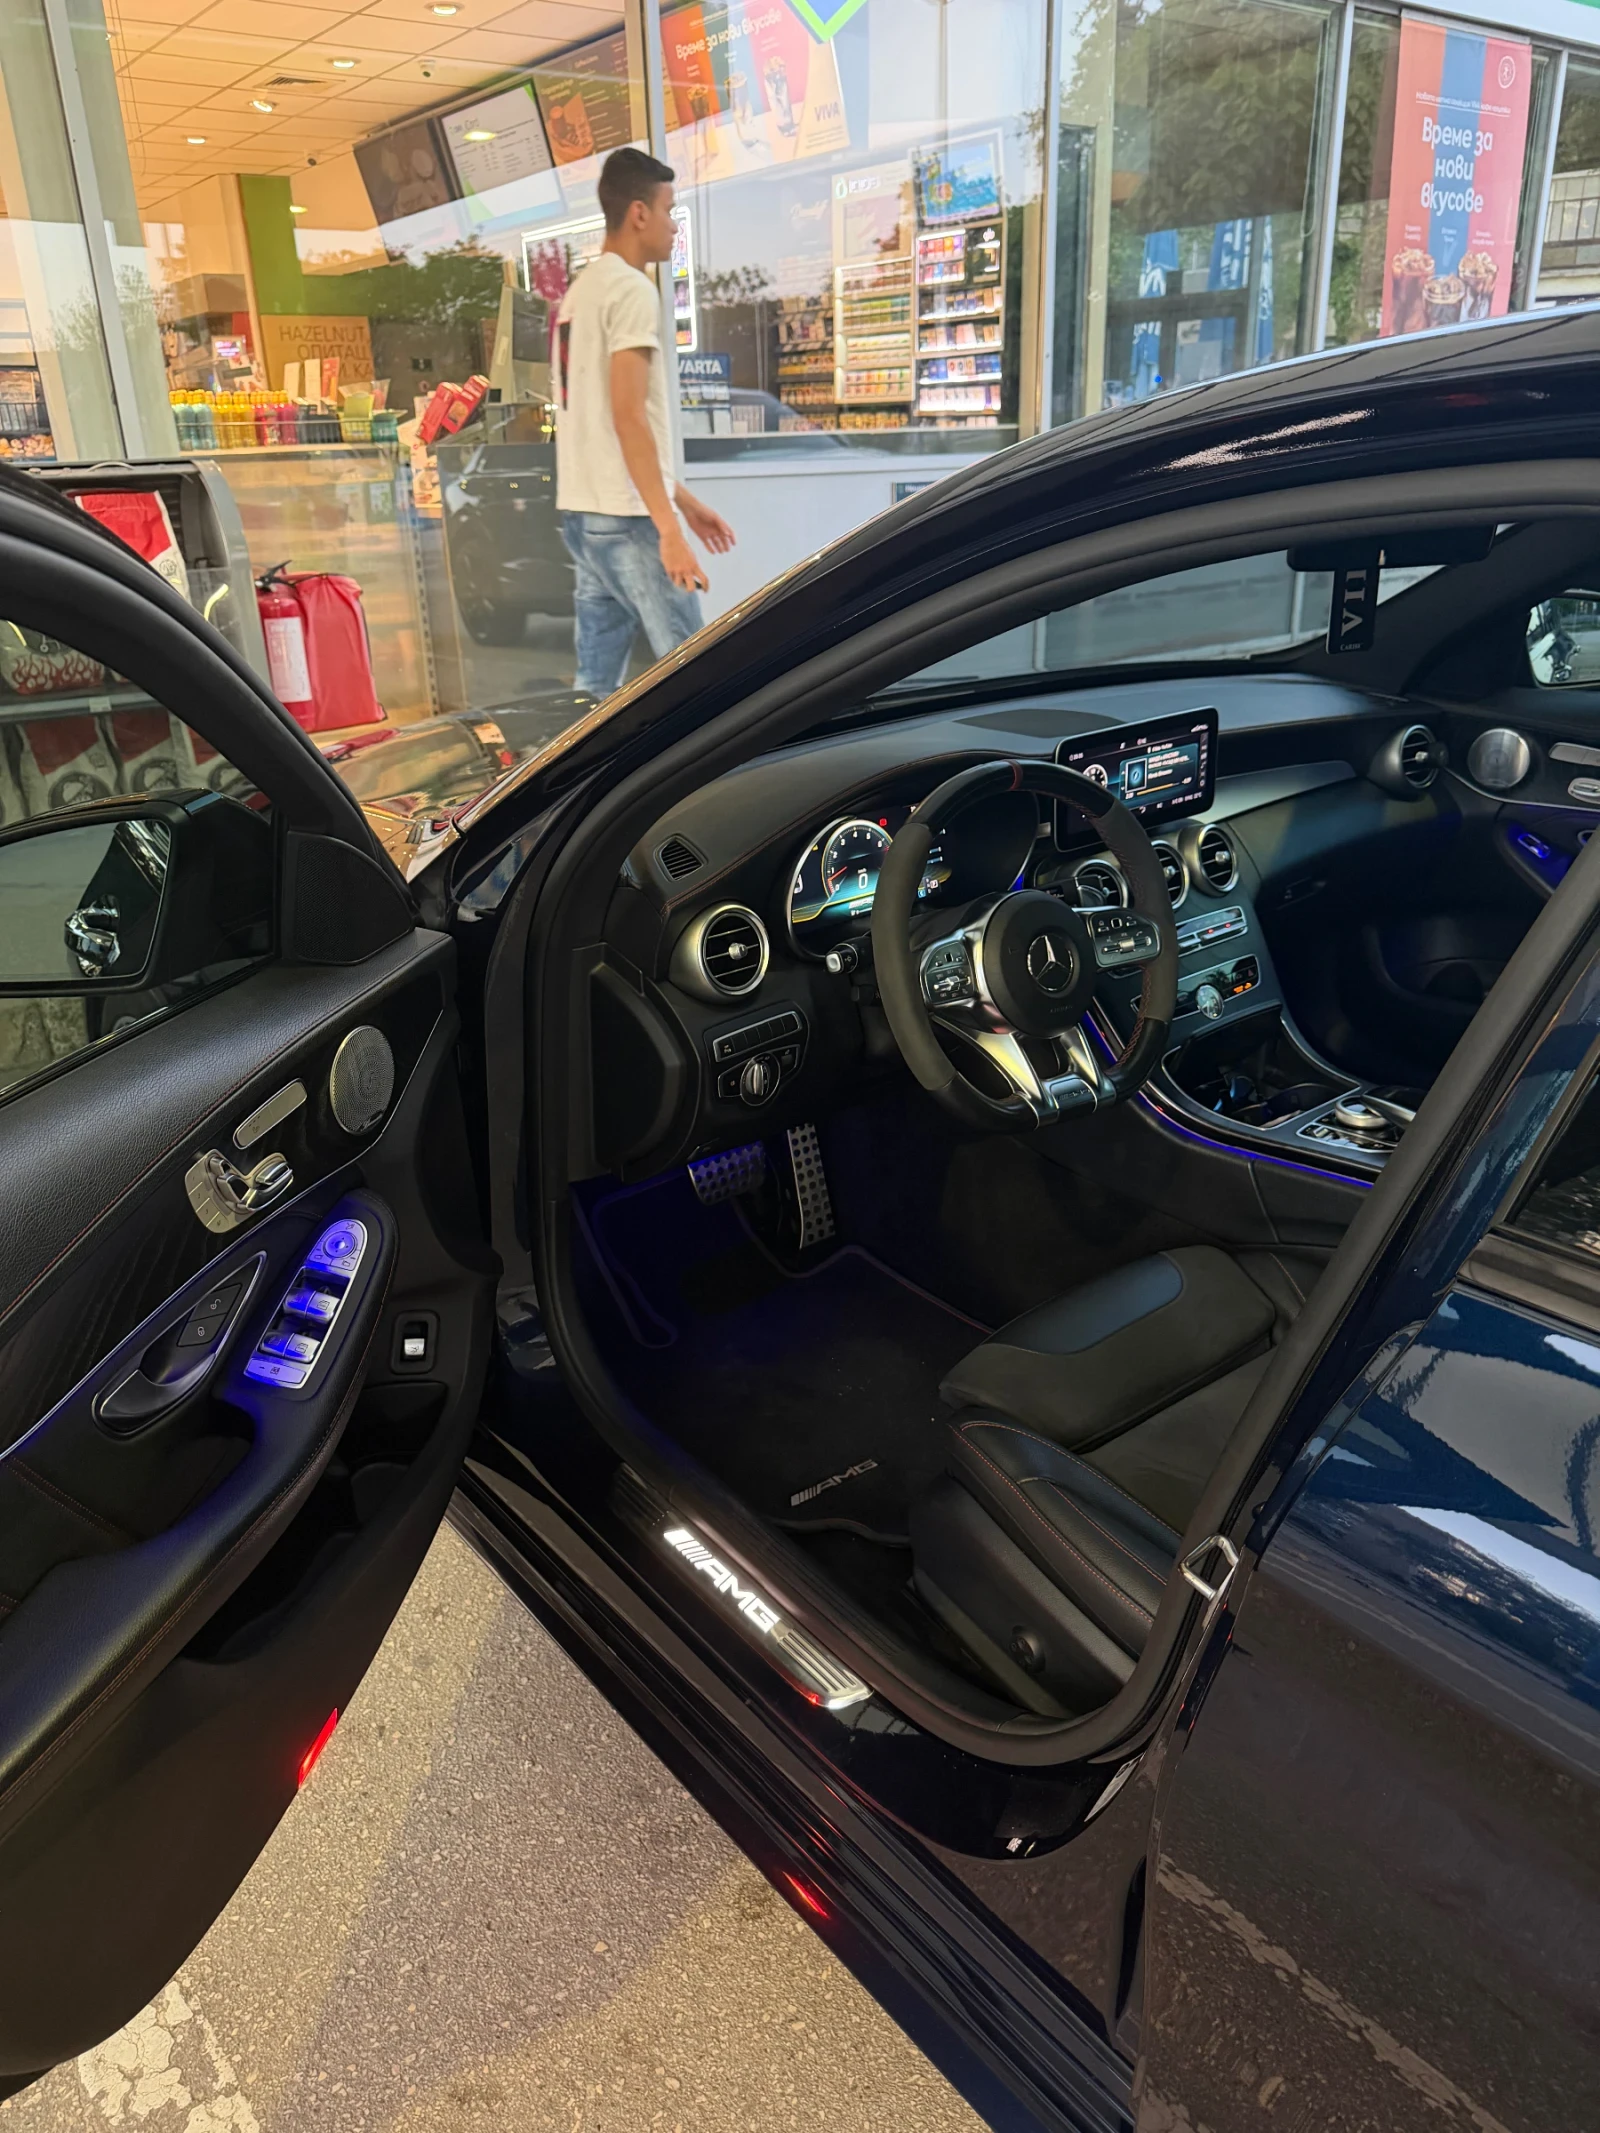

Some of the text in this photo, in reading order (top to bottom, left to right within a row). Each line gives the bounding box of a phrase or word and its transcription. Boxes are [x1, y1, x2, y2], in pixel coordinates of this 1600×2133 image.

[814, 101, 841, 122] VIVA
[1422, 116, 1494, 156] Време за
[1435, 154, 1474, 181] нови
[1420, 182, 1484, 217] вкусове
[858, 872, 869, 889] 0
[694, 1557, 781, 1634] AMG
